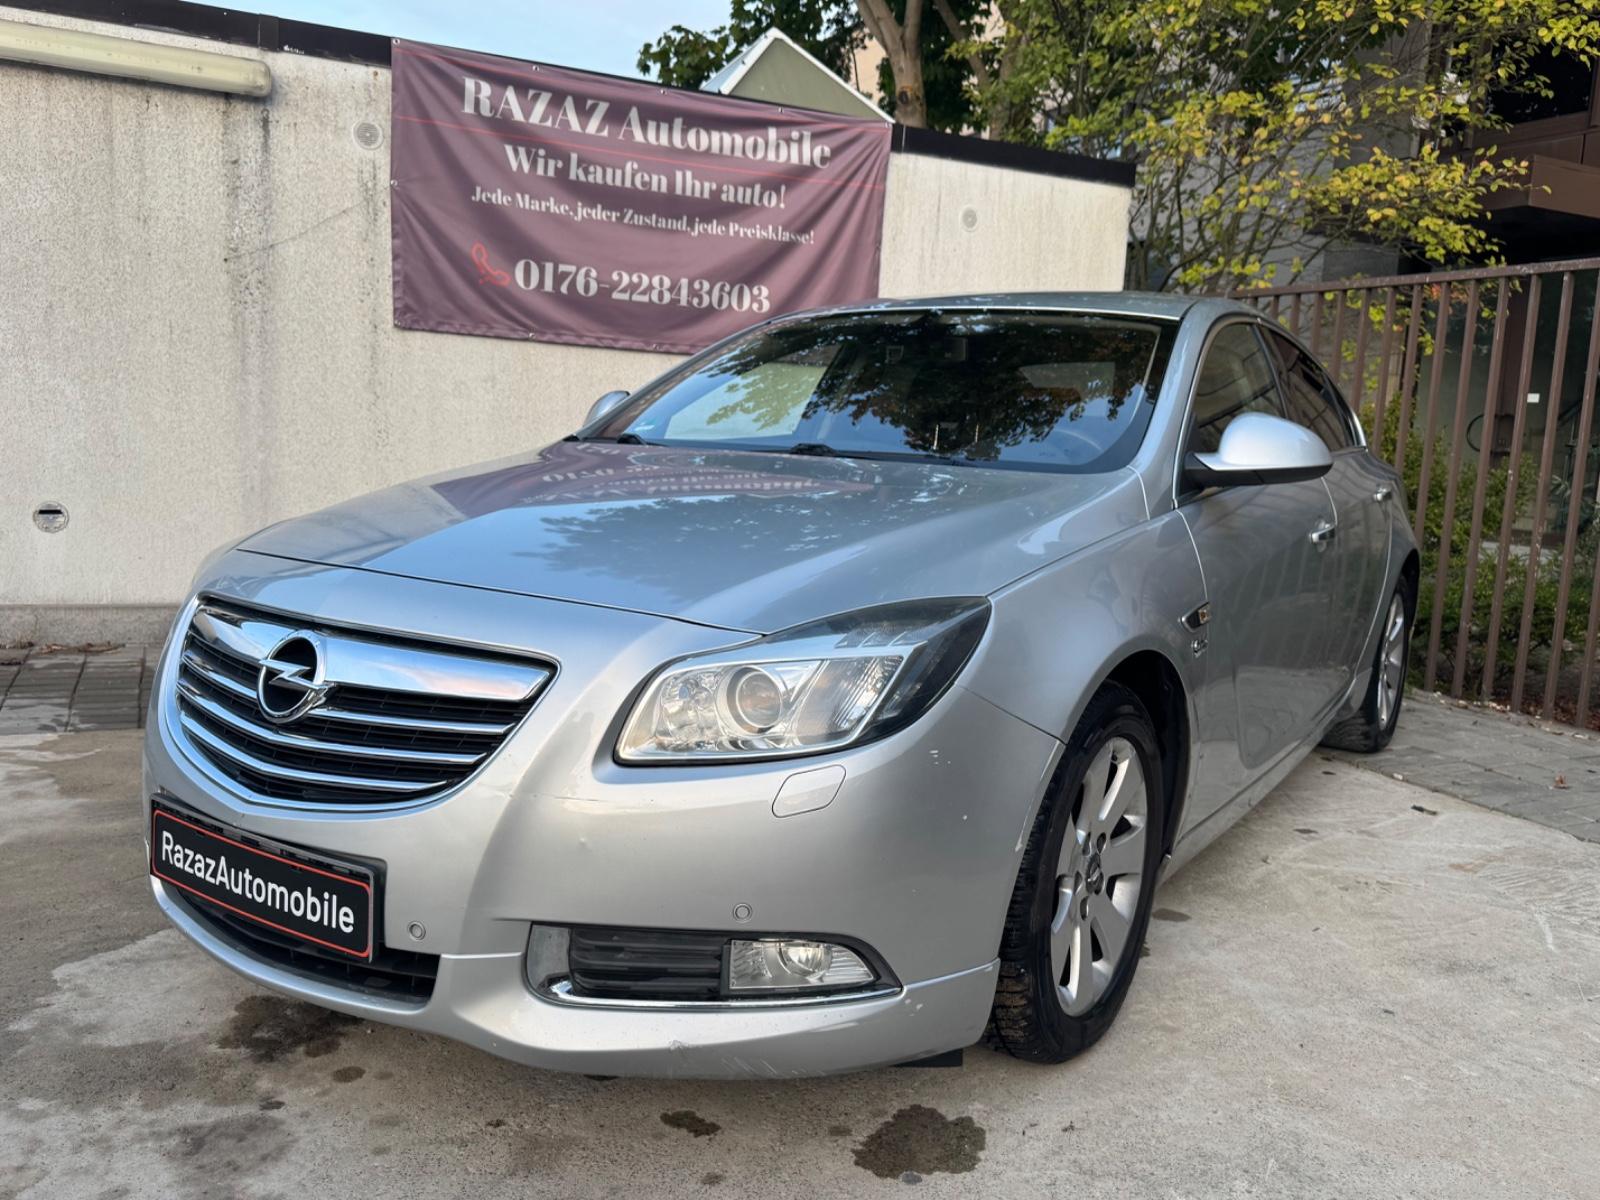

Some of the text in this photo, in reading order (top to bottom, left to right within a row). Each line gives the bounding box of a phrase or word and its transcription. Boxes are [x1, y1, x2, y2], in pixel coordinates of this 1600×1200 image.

[461, 76, 831, 169] RAZAZ Automobile
[504, 145, 787, 209] Wir kaufen Ihr auto!
[471, 186, 512, 206] Jede
[729, 222, 815, 244] Preisklasse!
[514, 259, 771, 314] 0176-22843603
[161, 830, 355, 933] RazazAutomobile
